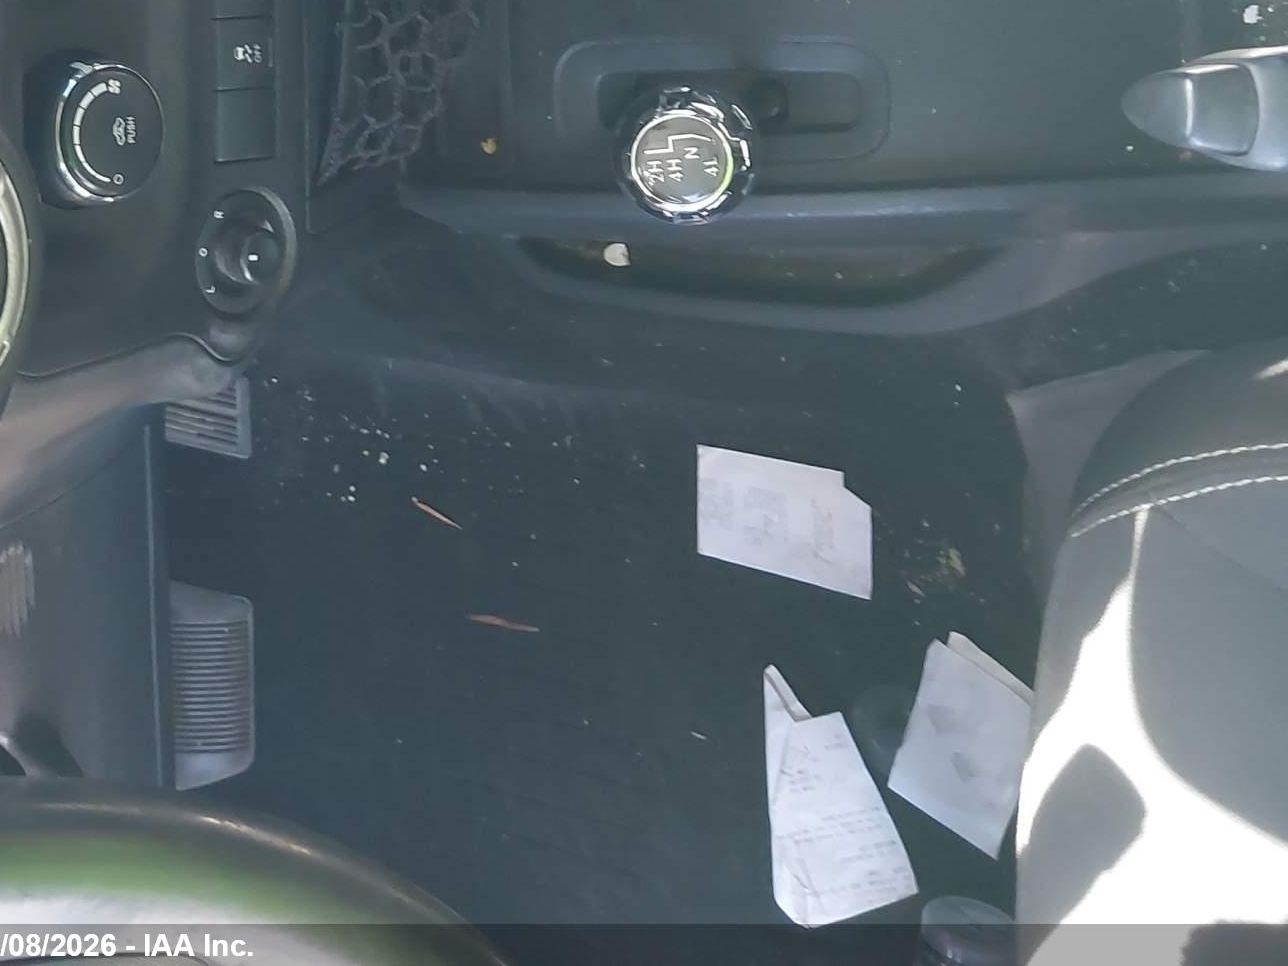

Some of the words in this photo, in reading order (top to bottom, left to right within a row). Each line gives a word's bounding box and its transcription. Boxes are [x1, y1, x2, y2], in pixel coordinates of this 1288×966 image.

[250, 44, 261, 63] OFF
[124, 117, 135, 143] PUSH
[684, 148, 699, 159] N
[646, 161, 665, 183] 2H
[665, 159, 684, 182] 4H
[704, 160, 718, 176] 4L
